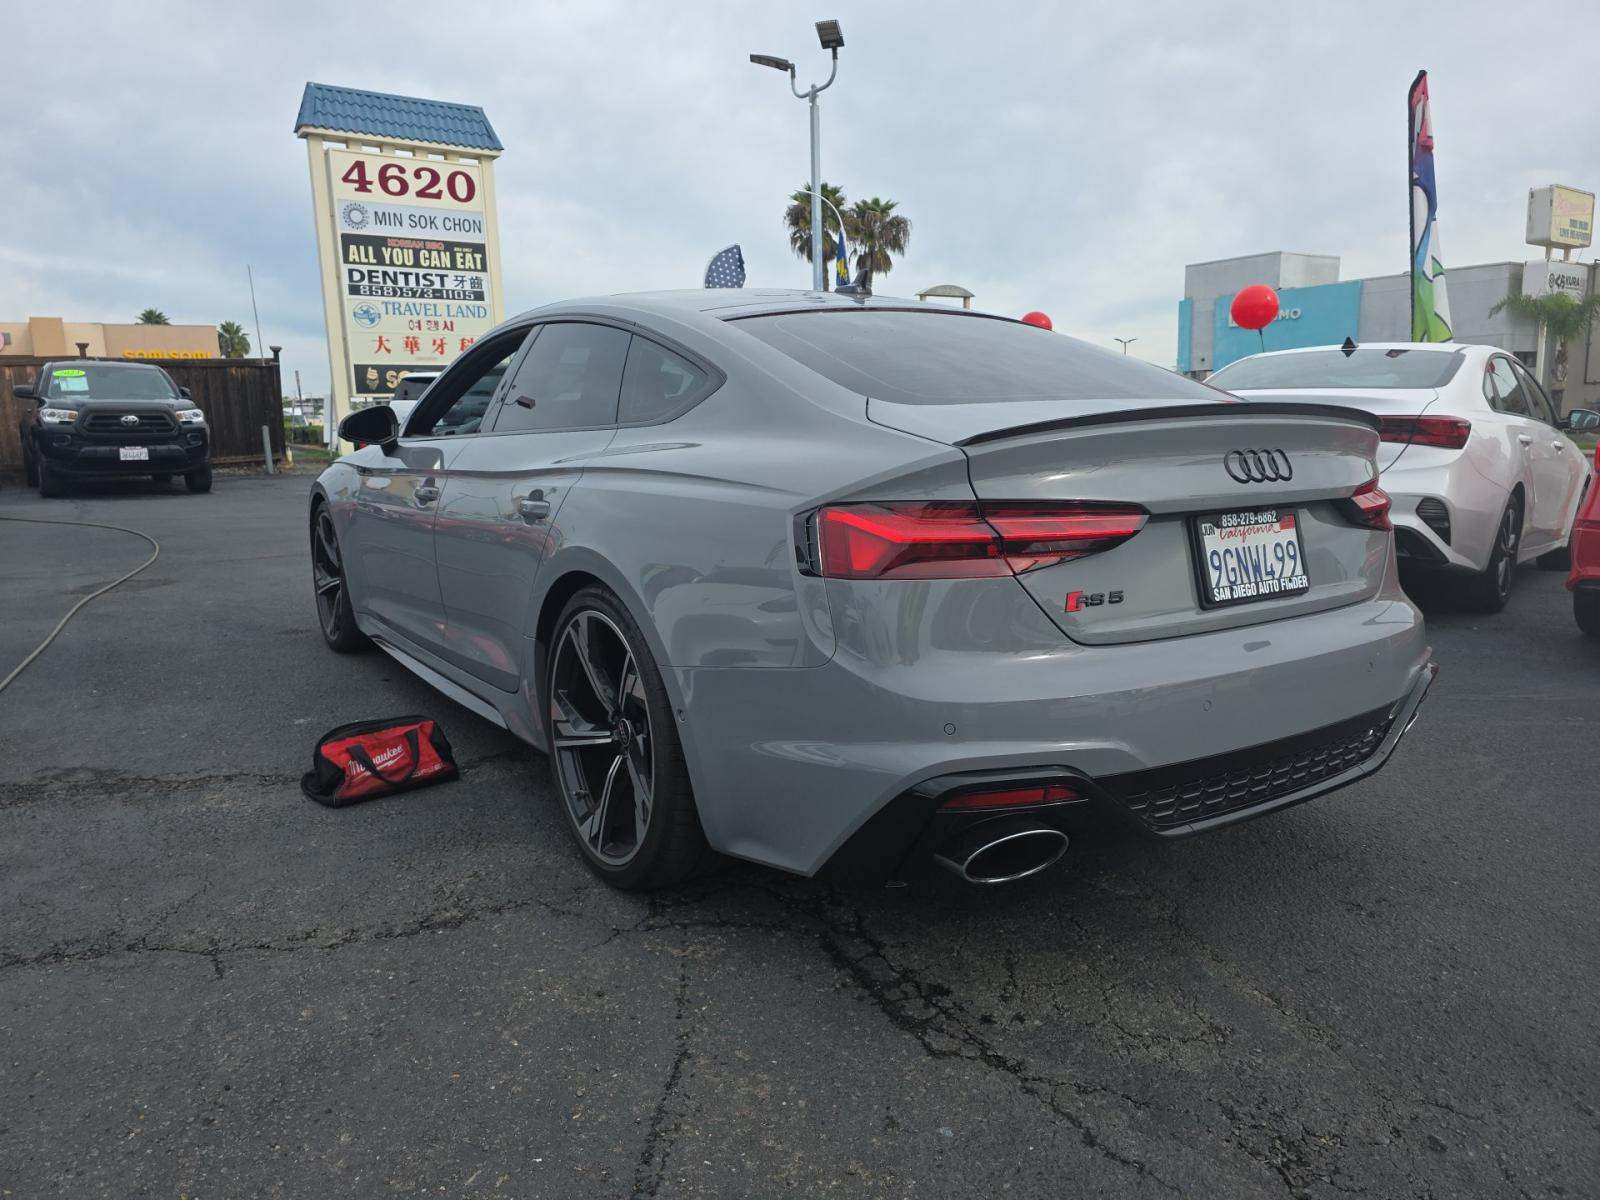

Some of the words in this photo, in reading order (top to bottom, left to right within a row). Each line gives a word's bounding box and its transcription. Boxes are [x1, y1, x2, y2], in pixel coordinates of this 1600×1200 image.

[341, 160, 476, 203] 4620
[374, 211, 403, 228] MIN
[408, 214, 439, 230] SOK
[442, 217, 482, 234] CHON
[348, 245, 377, 264] ALL
[382, 247, 414, 266] YOU
[420, 249, 451, 268] CAN
[456, 251, 483, 271] EAT
[348, 268, 449, 288] DENTIST
[381, 301, 443, 317] TRAVEL
[446, 304, 487, 319] LAND
[1213, 586, 1232, 602] SAN
[1232, 583, 1257, 599] DIEGO
[1259, 579, 1280, 595] AUTO
[1281, 575, 1309, 591] FINDER
